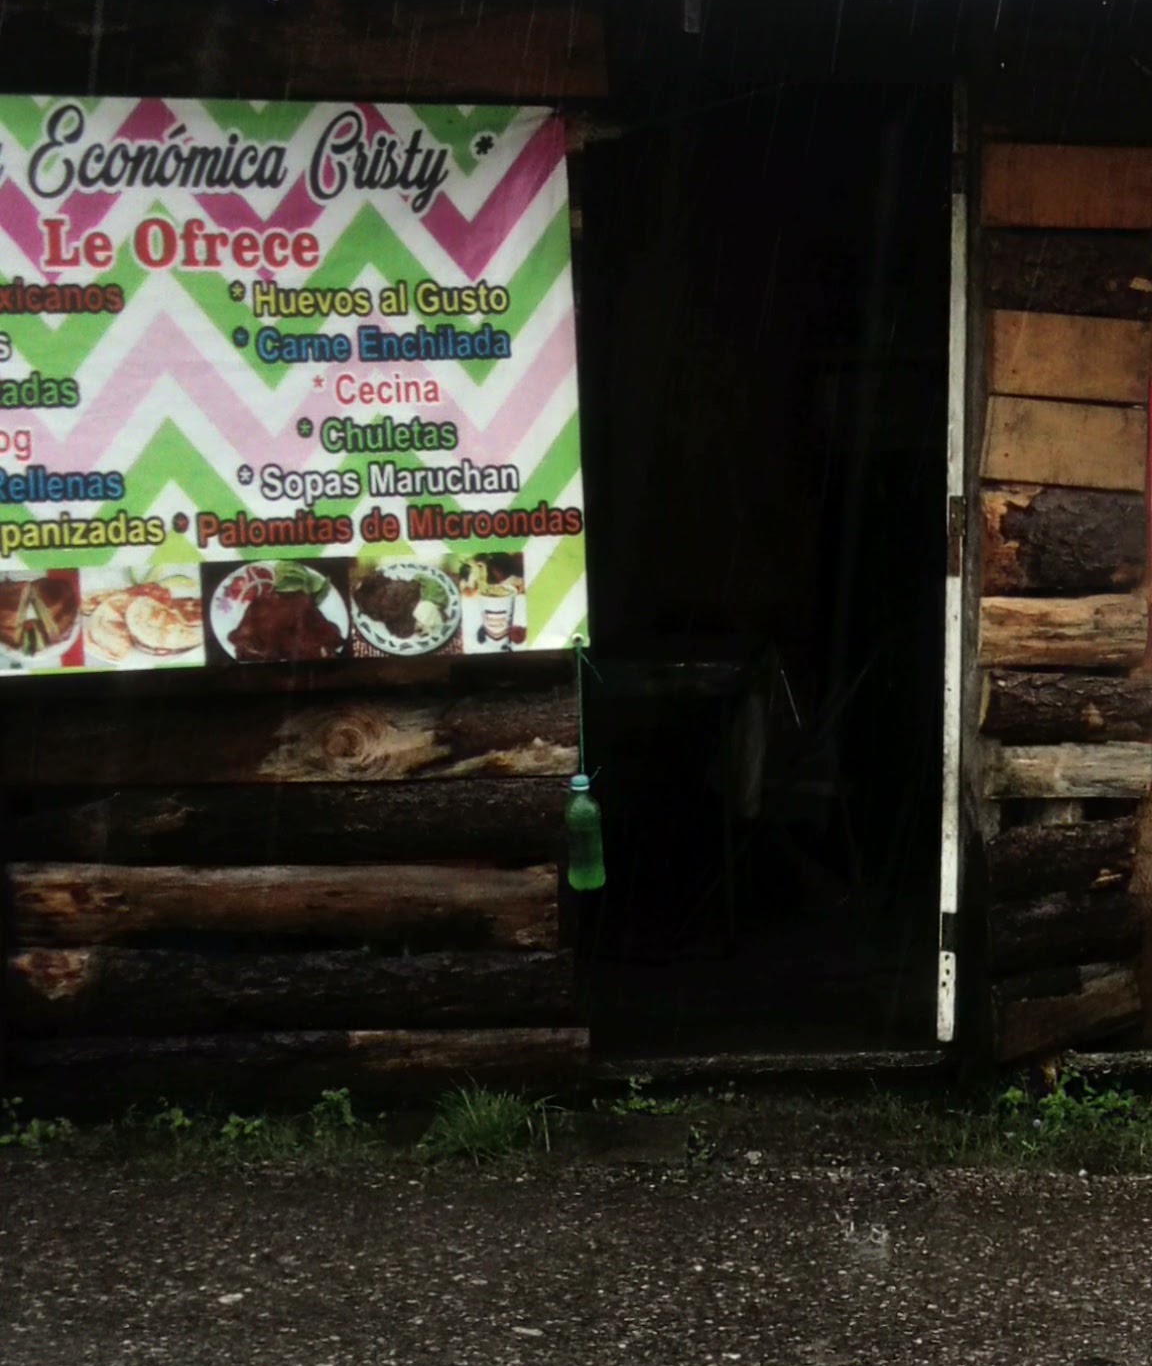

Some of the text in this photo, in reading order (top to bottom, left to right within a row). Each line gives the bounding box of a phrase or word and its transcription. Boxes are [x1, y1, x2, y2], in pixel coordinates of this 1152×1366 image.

[28, 104, 448, 213] Económica Cristy
[43, 218, 319, 268] Le Ofrece
[253, 278, 510, 317] Huevos al Gusto
[256, 323, 512, 363] Carne Enchilada
[335, 374, 440, 405] Cecina
[320, 416, 458, 454] Chuletas
[260, 458, 520, 507] Sopas Maruchan
[196, 501, 584, 548] Palomitas de Microondas
